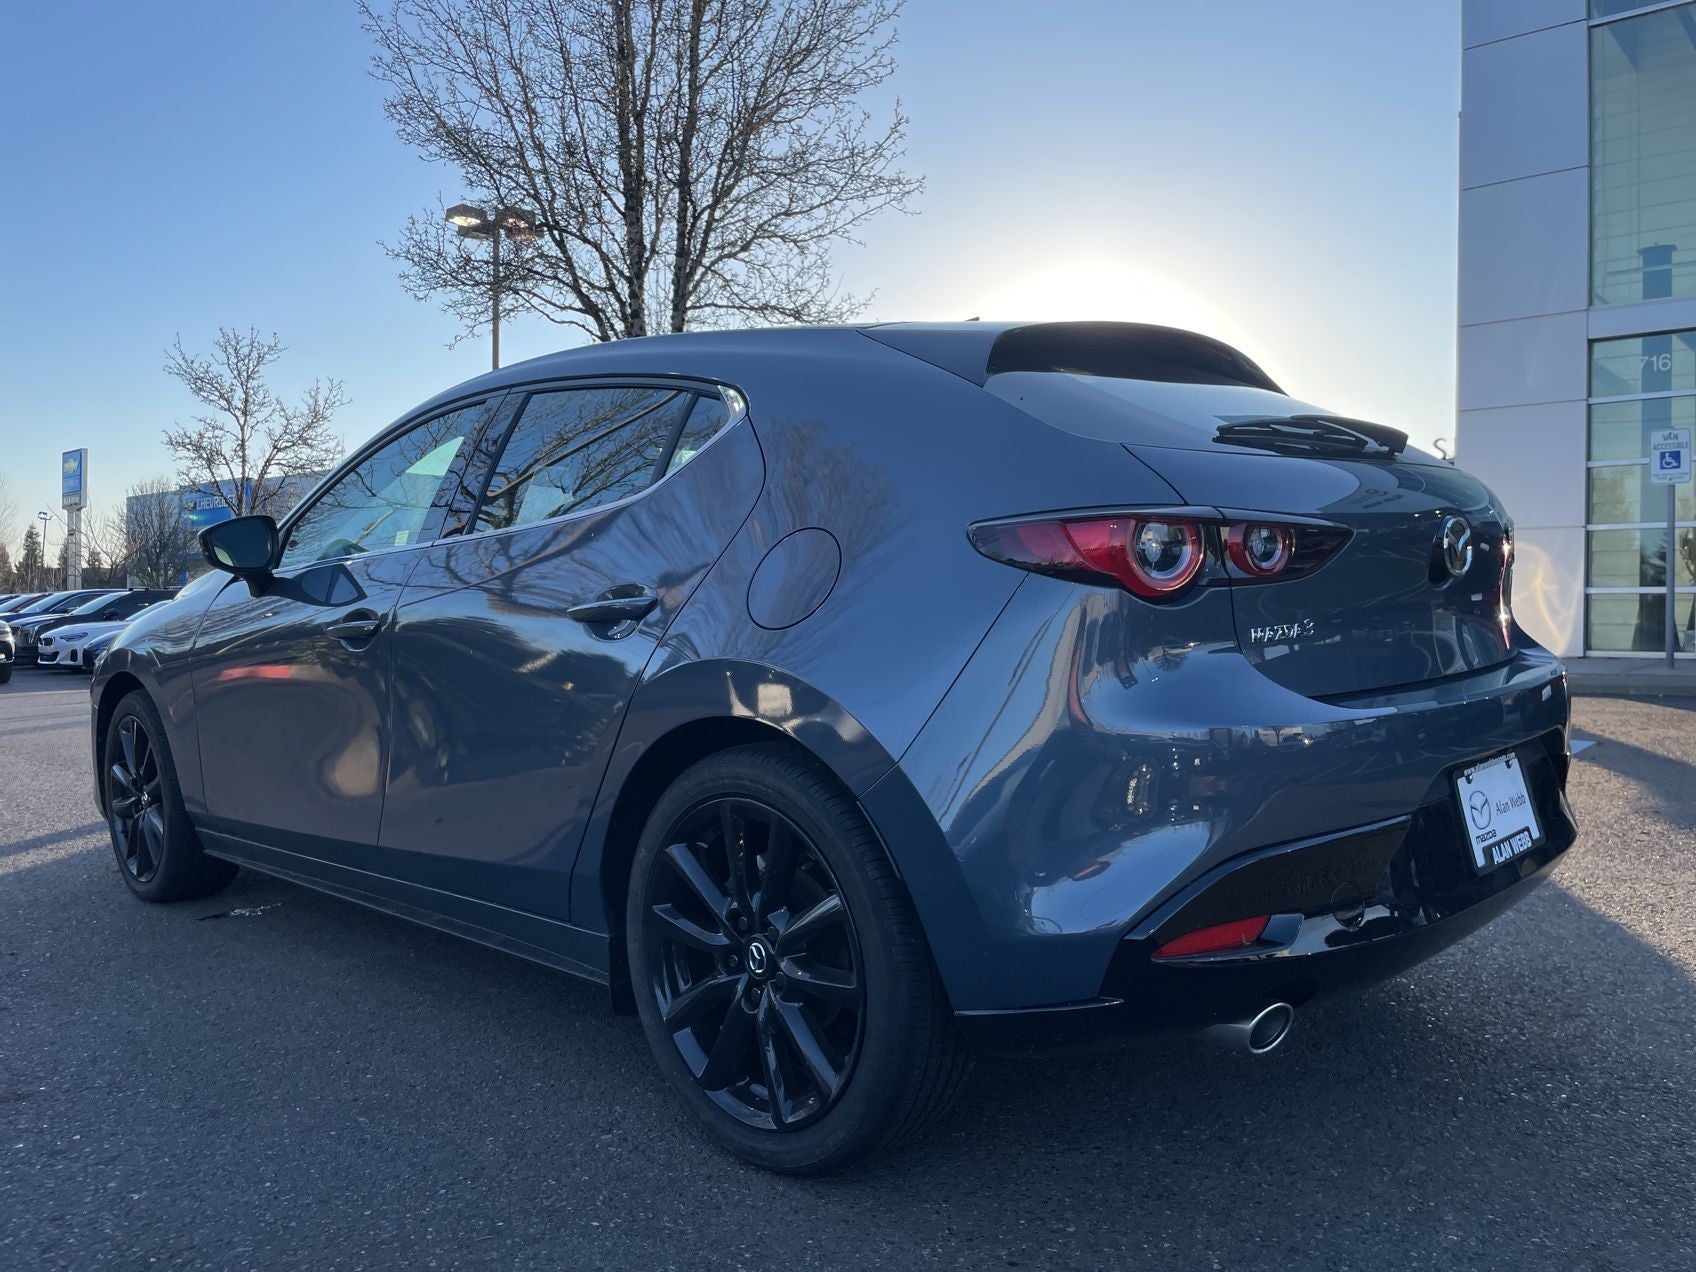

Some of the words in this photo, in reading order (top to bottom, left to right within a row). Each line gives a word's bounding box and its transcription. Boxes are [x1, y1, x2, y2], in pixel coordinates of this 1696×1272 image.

[1662, 432, 1679, 441] VAN
[1653, 441, 1689, 450] ACCESSIBLE
[1495, 799, 1511, 817] Alan
[1511, 791, 1526, 809] Webb
[1491, 839, 1513, 865] ALAN
[1510, 830, 1532, 855] WEBB
